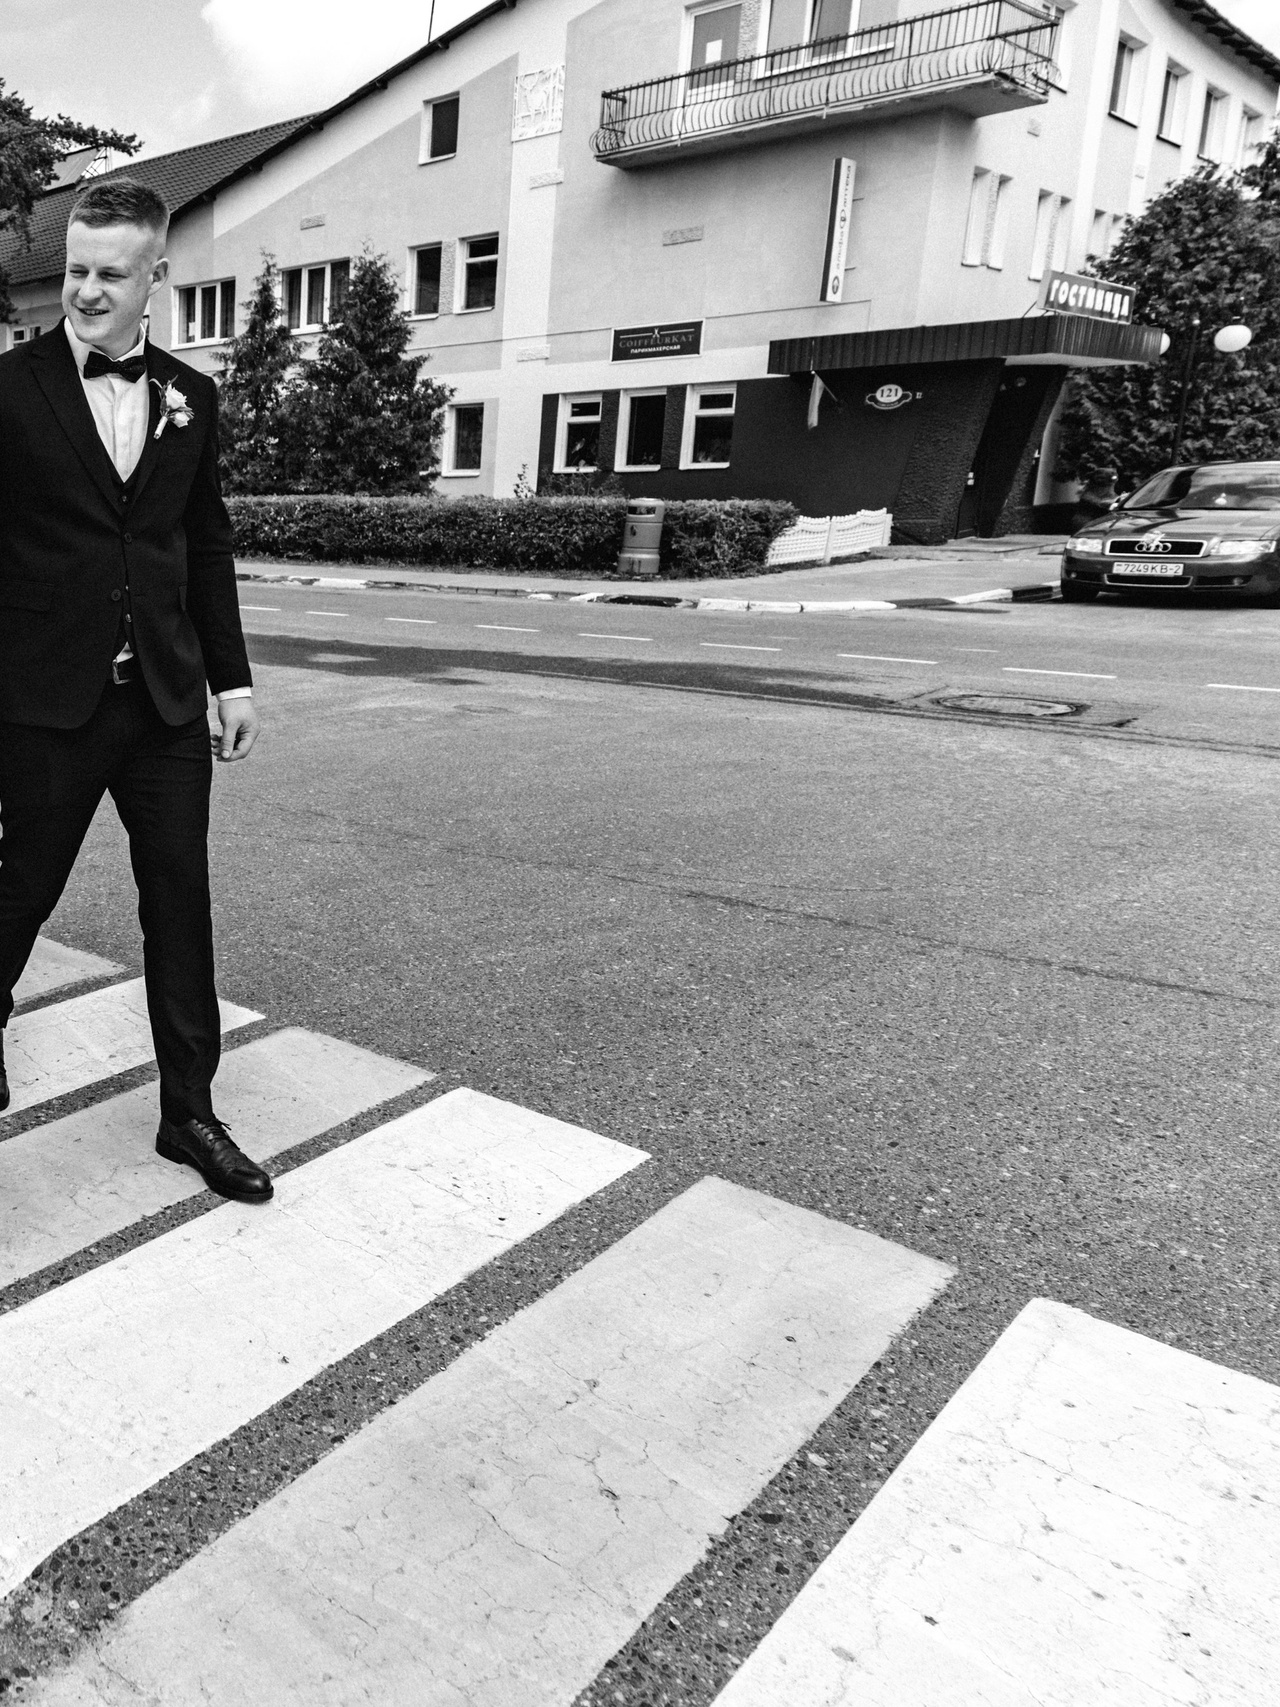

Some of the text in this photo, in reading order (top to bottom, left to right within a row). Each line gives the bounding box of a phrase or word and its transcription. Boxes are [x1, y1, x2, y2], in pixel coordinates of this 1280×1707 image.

[1049, 279, 1130, 318] ГОСТИНИЦА
[630, 344, 681, 354] ПАРИКМАХЕРСКАЯ
[880, 388, 899, 398] 121
